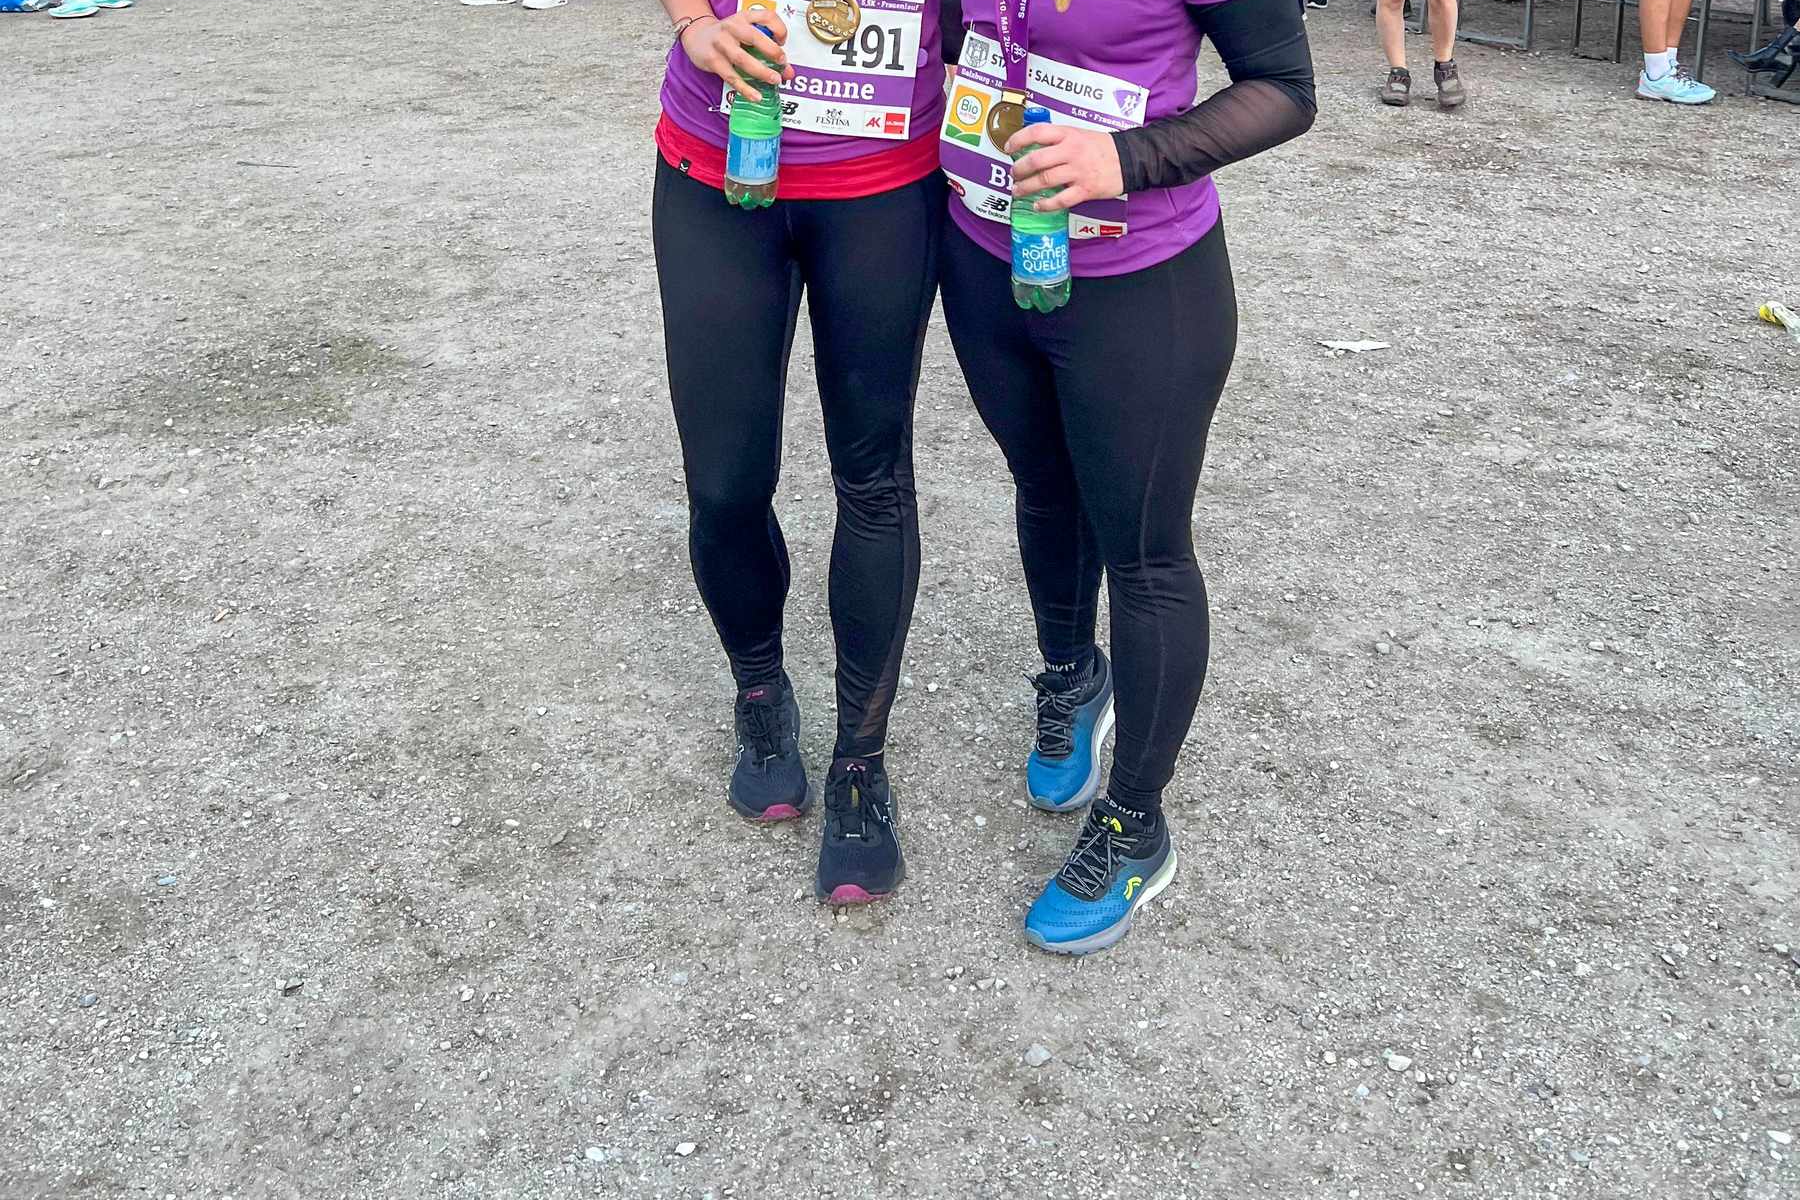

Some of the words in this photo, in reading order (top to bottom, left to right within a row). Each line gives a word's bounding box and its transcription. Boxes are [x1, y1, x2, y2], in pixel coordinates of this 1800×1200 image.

[881, 0, 920, 11] Frauenlauf
[831, 24, 906, 71] 491
[961, 68, 991, 85] Salzburg
[1034, 69, 1104, 101] SALZBURG
[779, 73, 876, 101] usanne
[960, 98, 979, 115] Bio
[815, 115, 851, 127] FESTINA
[865, 116, 882, 129] AK
[975, 206, 988, 214] new
[1078, 225, 1096, 235] AK
[1023, 257, 1067, 274] QUELLE
